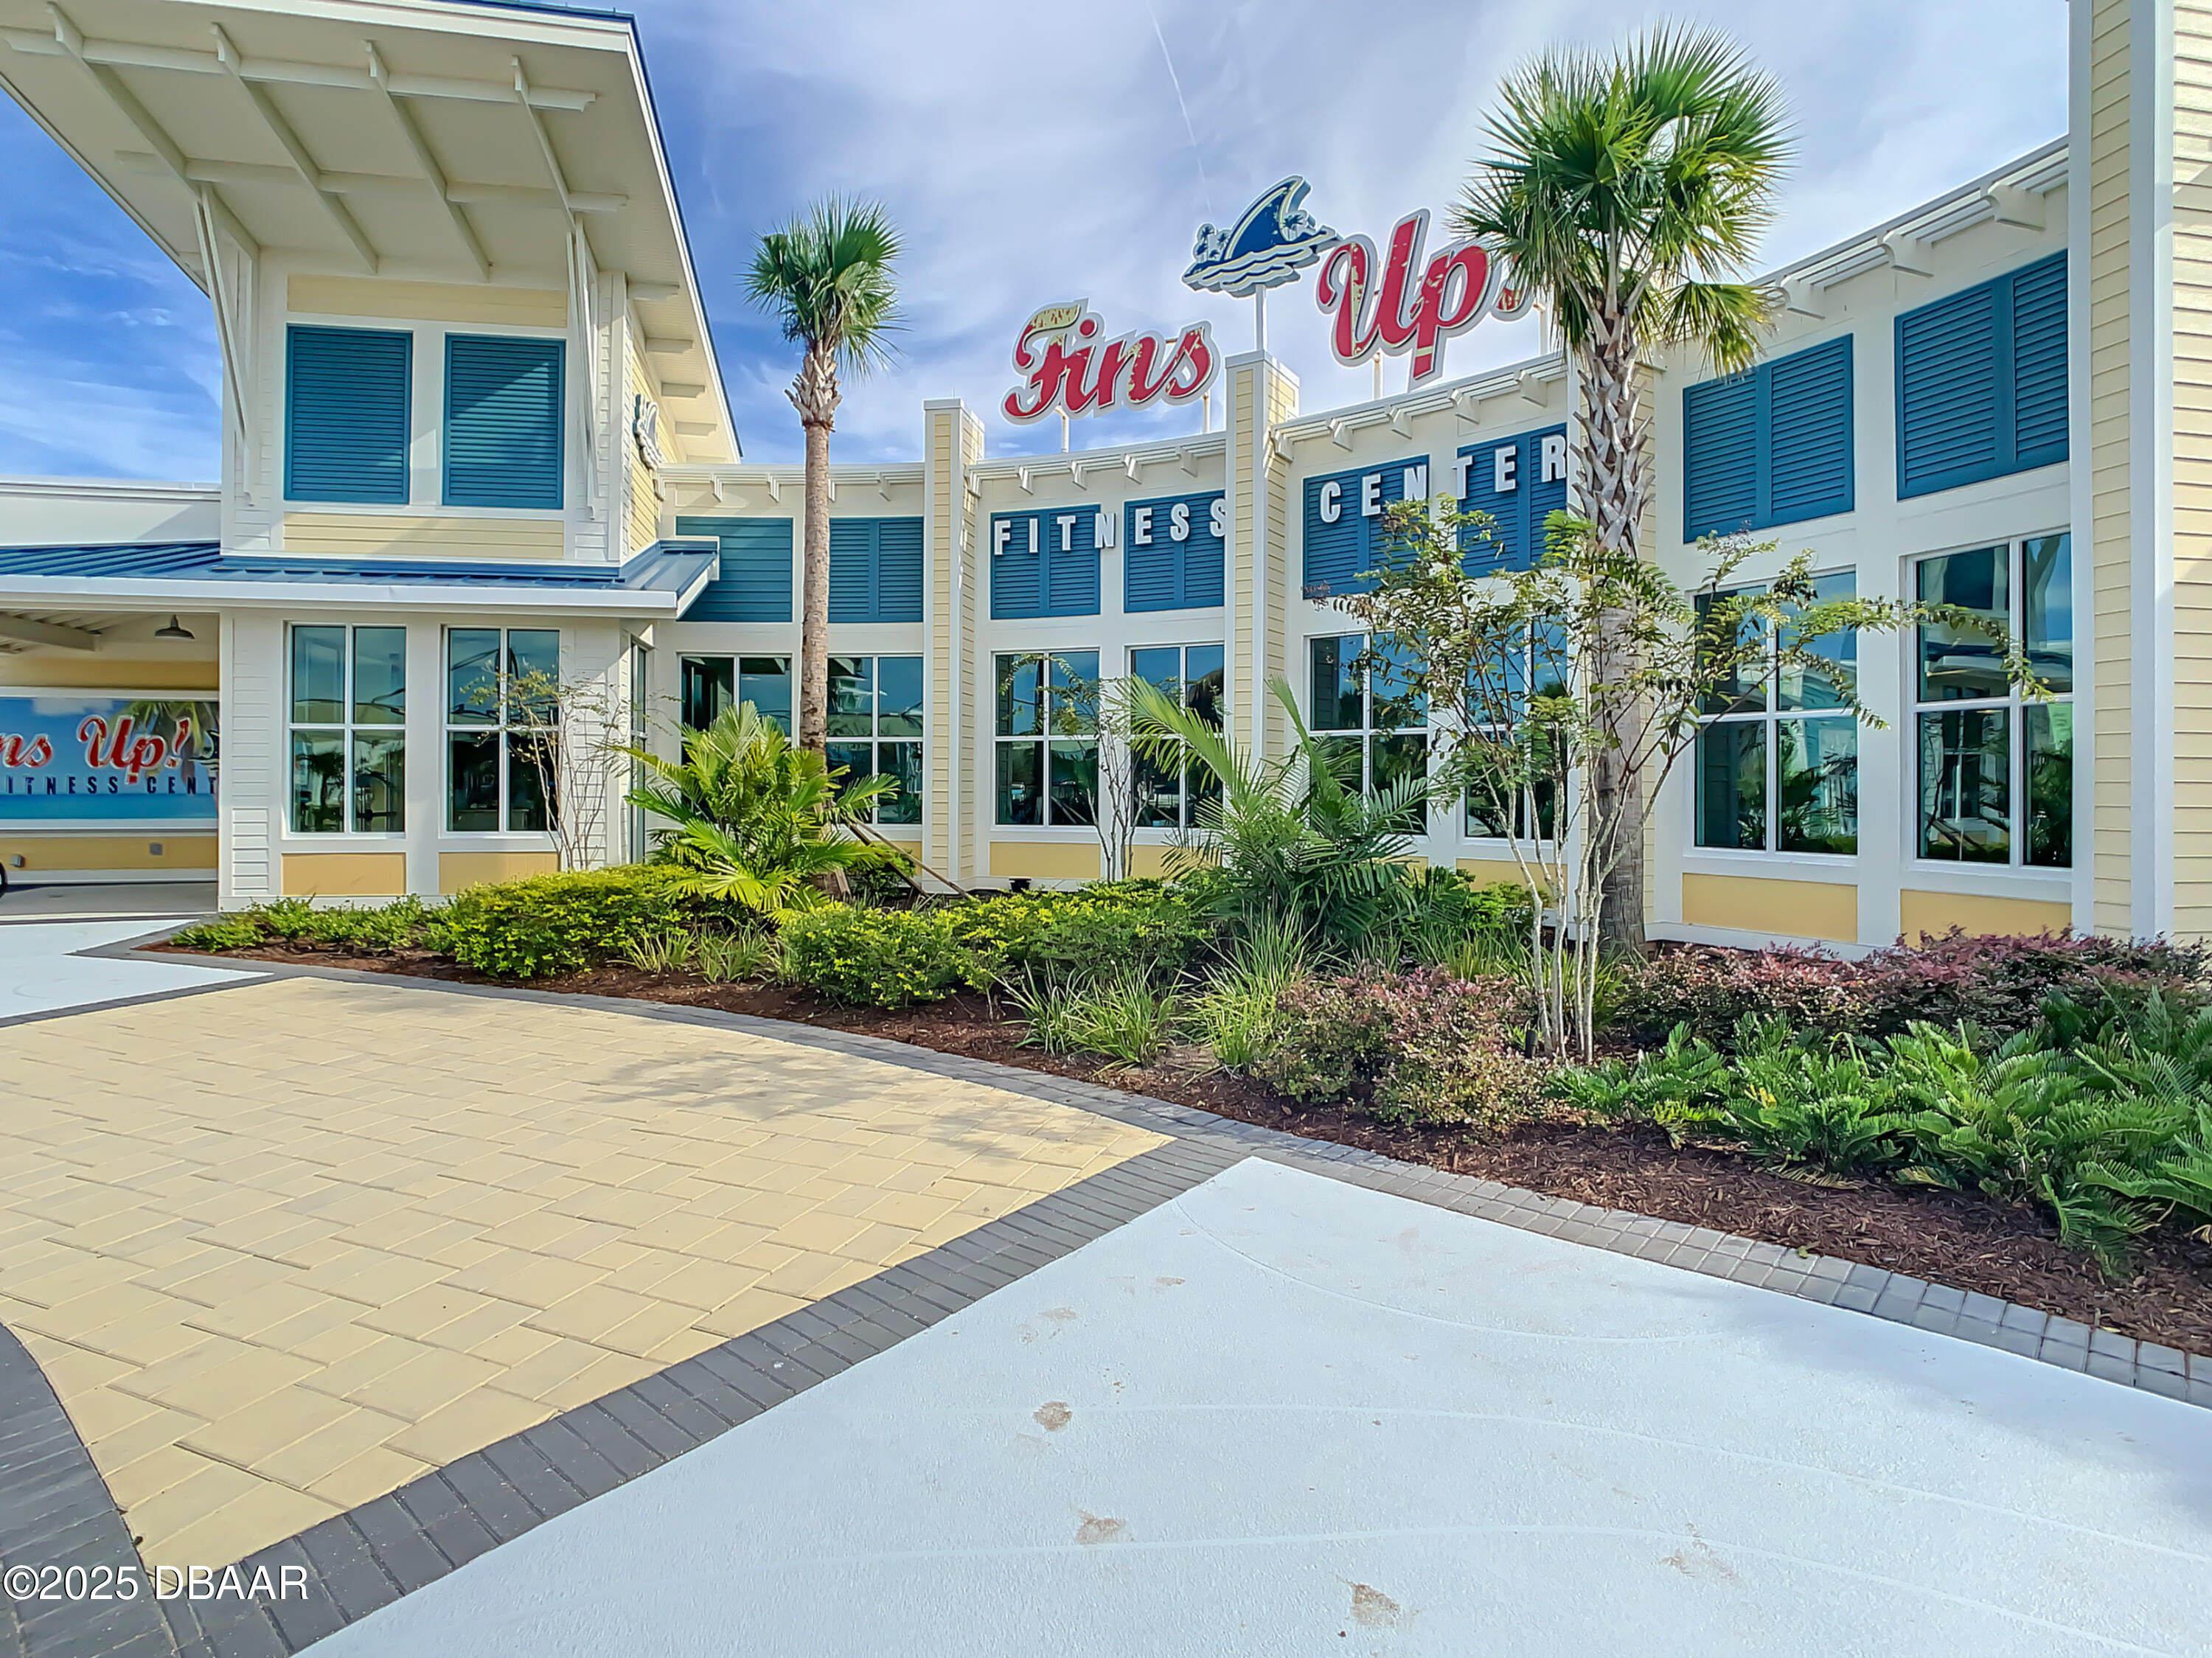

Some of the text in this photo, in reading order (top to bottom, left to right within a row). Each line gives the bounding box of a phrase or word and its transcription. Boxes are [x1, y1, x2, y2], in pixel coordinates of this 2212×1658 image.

[1004, 303, 1215, 420] Fins
[993, 433, 1568, 556] FITNESS CENTER
[77, 714, 191, 785] Up!
